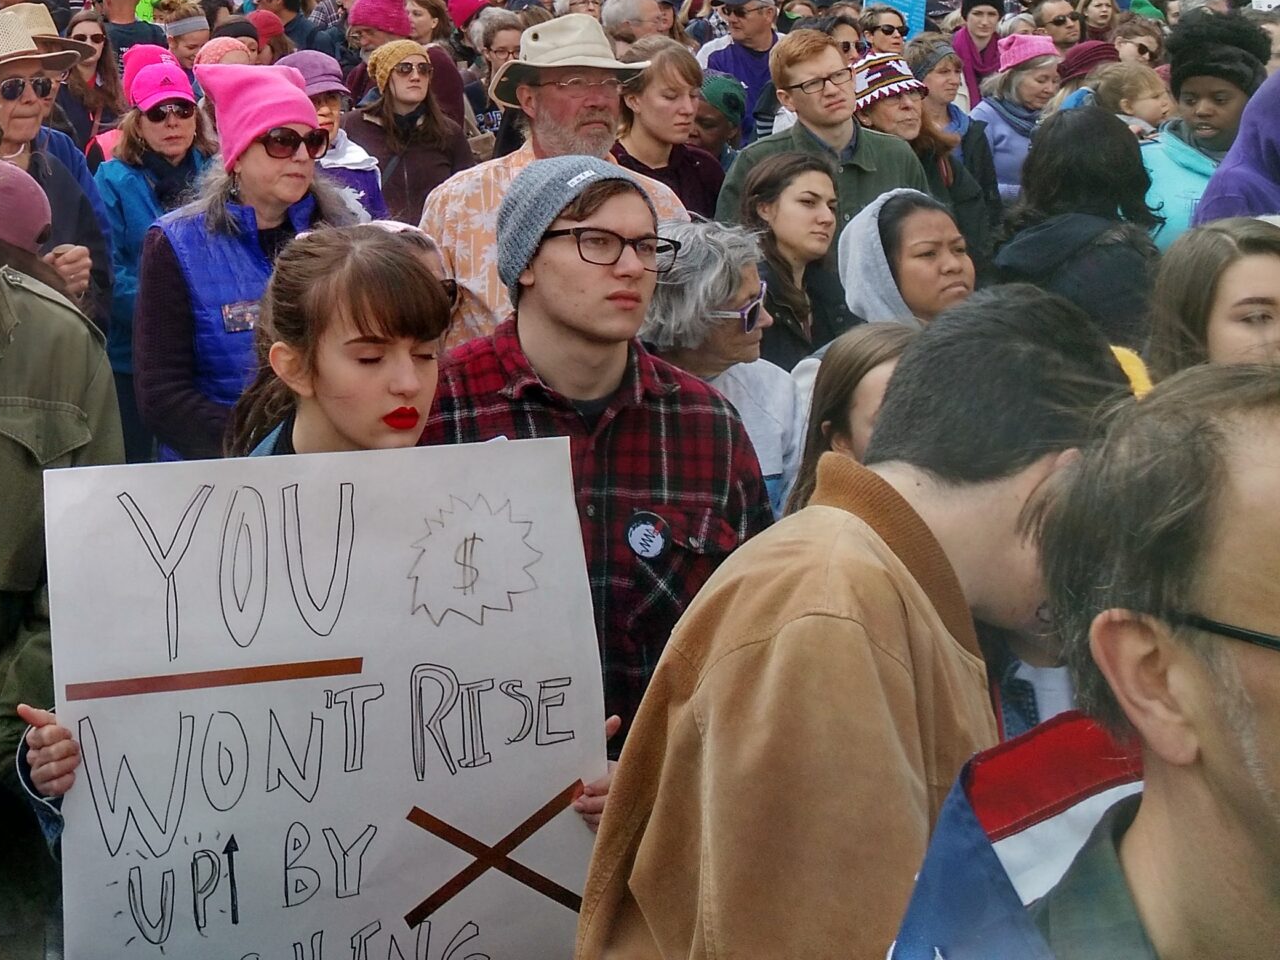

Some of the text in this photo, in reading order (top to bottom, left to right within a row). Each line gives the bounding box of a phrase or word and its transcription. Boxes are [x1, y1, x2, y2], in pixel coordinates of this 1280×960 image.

[117, 483, 355, 661] YOU
[78, 662, 575, 858] WON'T RISE
[282, 821, 378, 908] BY
